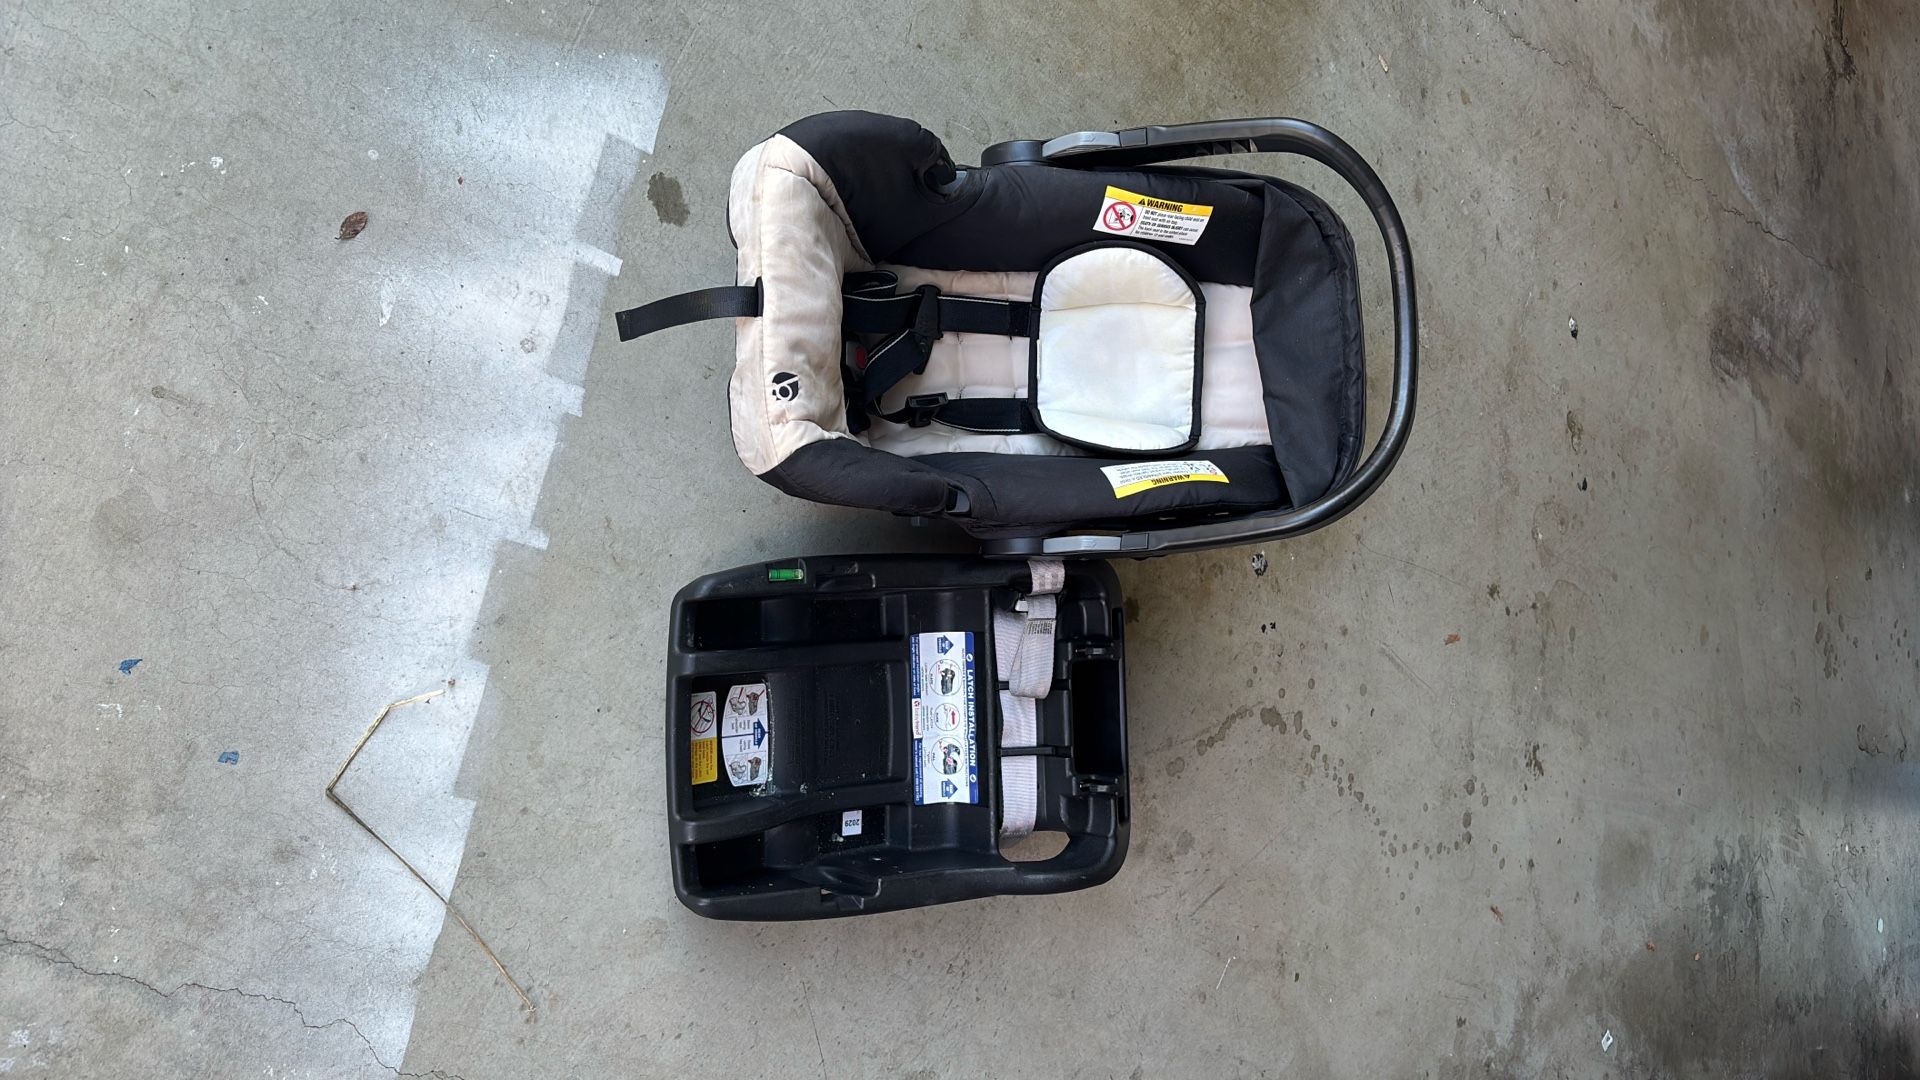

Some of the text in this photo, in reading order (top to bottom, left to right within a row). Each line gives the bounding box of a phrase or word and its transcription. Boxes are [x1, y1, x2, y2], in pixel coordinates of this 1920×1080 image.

[1147, 198, 1183, 212] WARNING
[1151, 474, 1184, 485] WARNING
[968, 701, 976, 766] INSTALLATION
